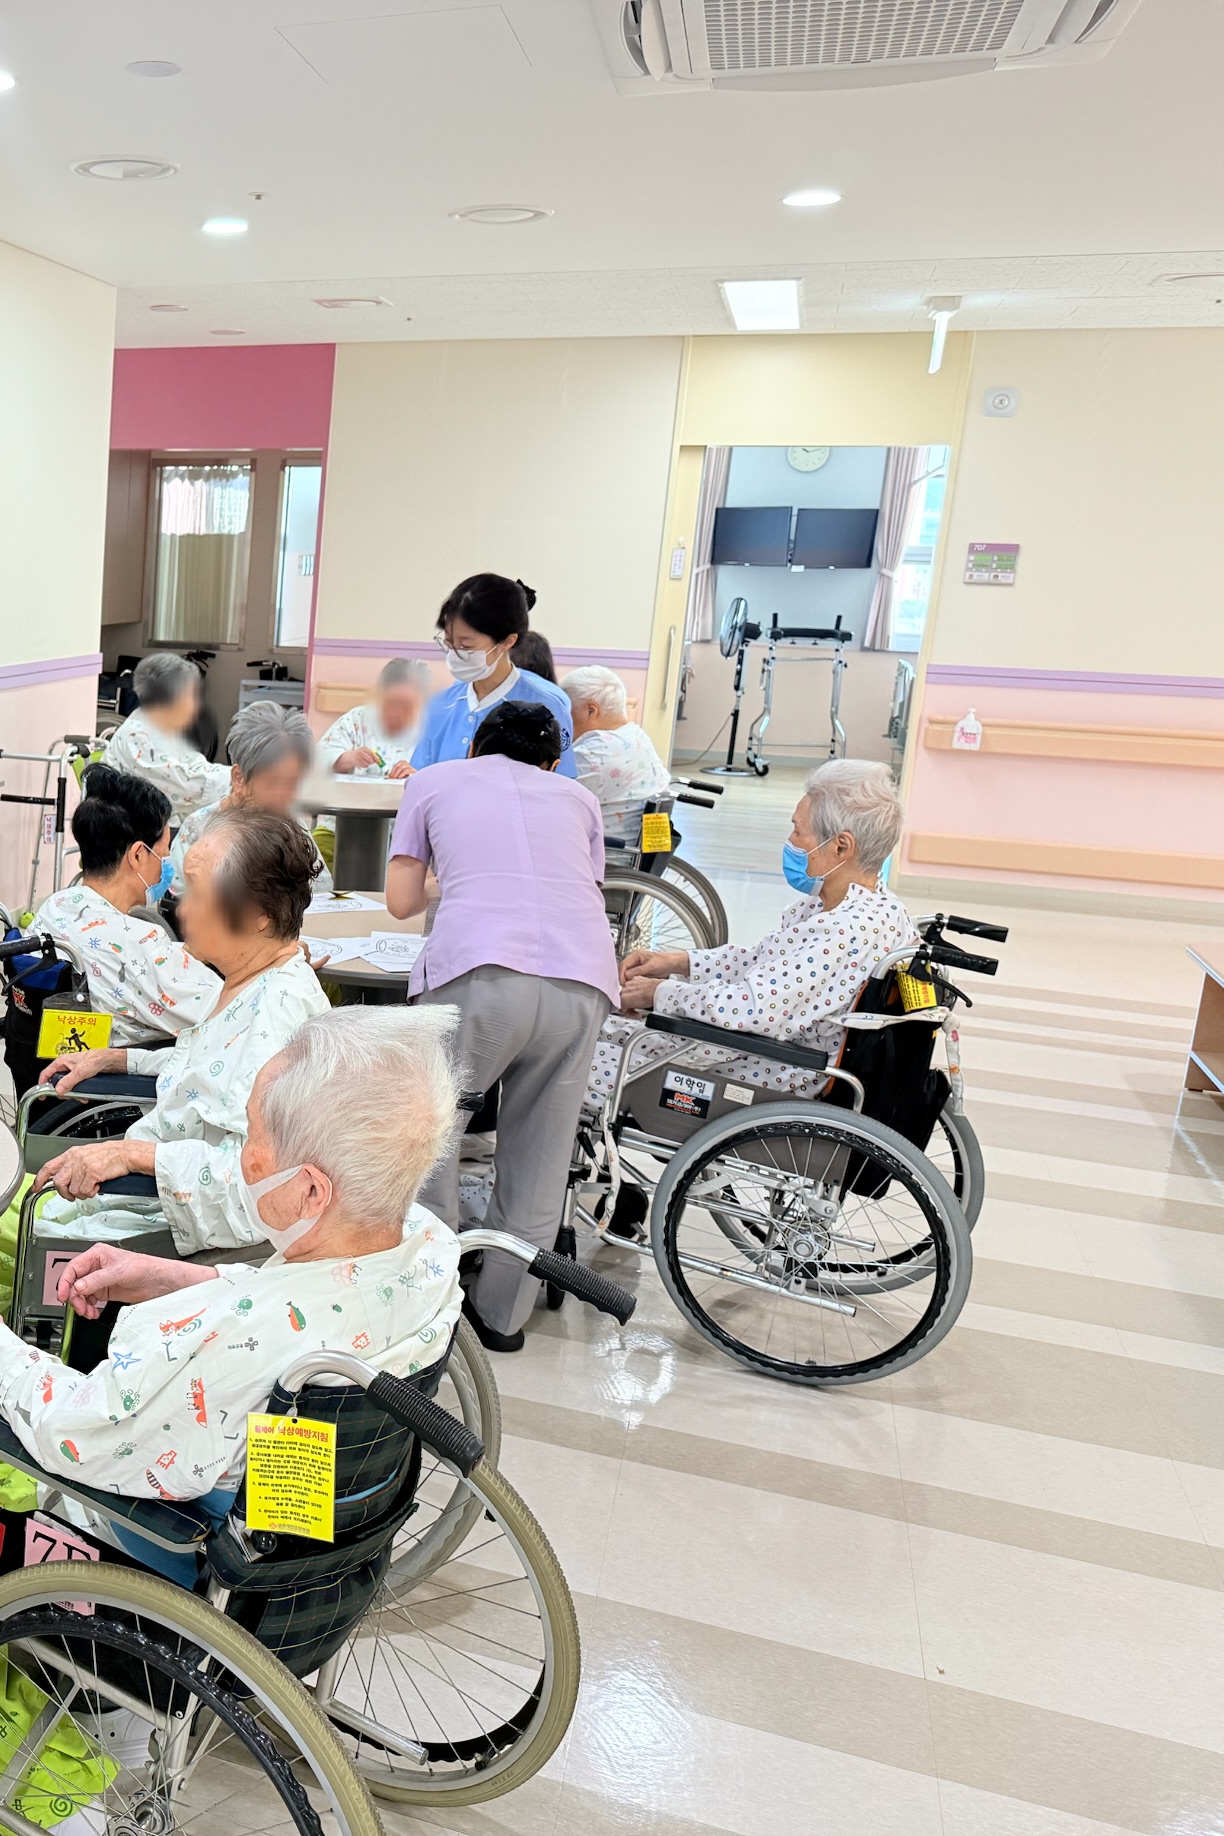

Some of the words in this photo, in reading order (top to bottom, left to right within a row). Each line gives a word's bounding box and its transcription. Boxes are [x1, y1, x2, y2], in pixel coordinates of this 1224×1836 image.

[57, 1015, 97, 1026] 낙상주의
[674, 1075, 706, 1094] 이학임
[255, 1425, 274, 1434] 휠체어
[278, 1426, 328, 1442] 낙상예방지침
